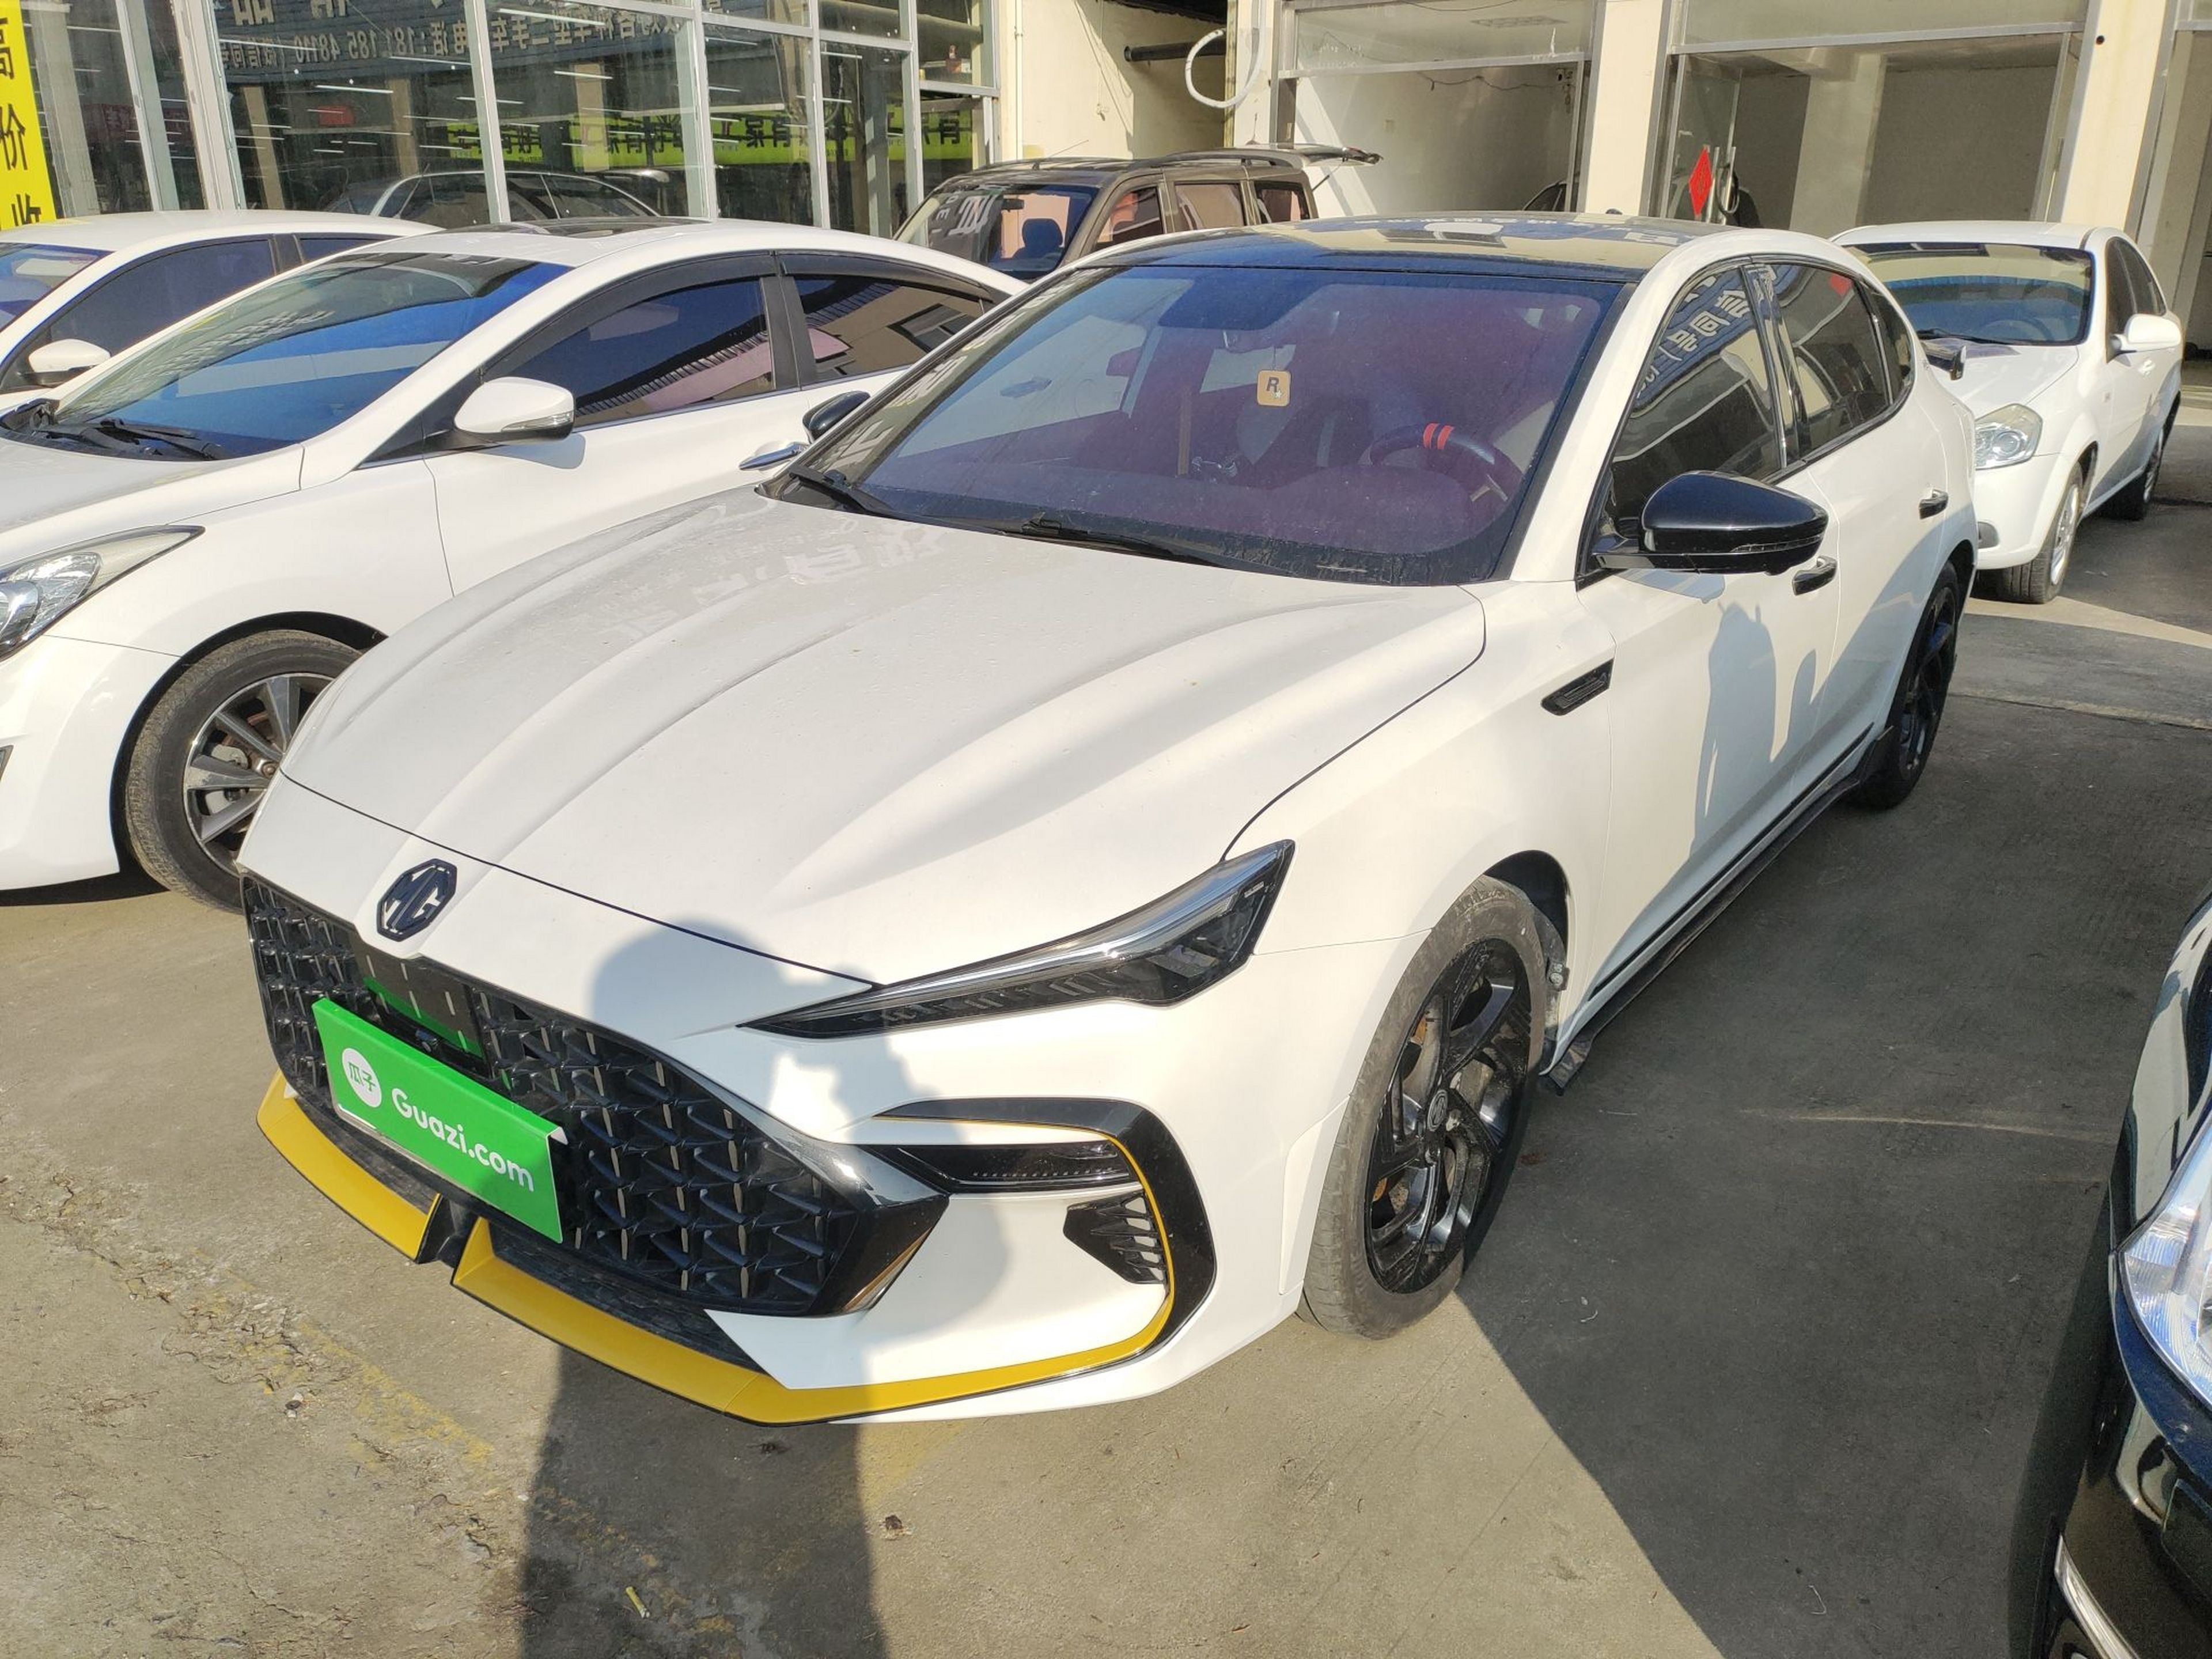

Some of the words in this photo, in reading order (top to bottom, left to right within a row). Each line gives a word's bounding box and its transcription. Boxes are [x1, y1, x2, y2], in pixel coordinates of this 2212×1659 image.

[1266, 376, 1280, 393] R
[347, 1060, 378, 1092] 瓜子
[391, 1088, 535, 1192] Guazi.com
